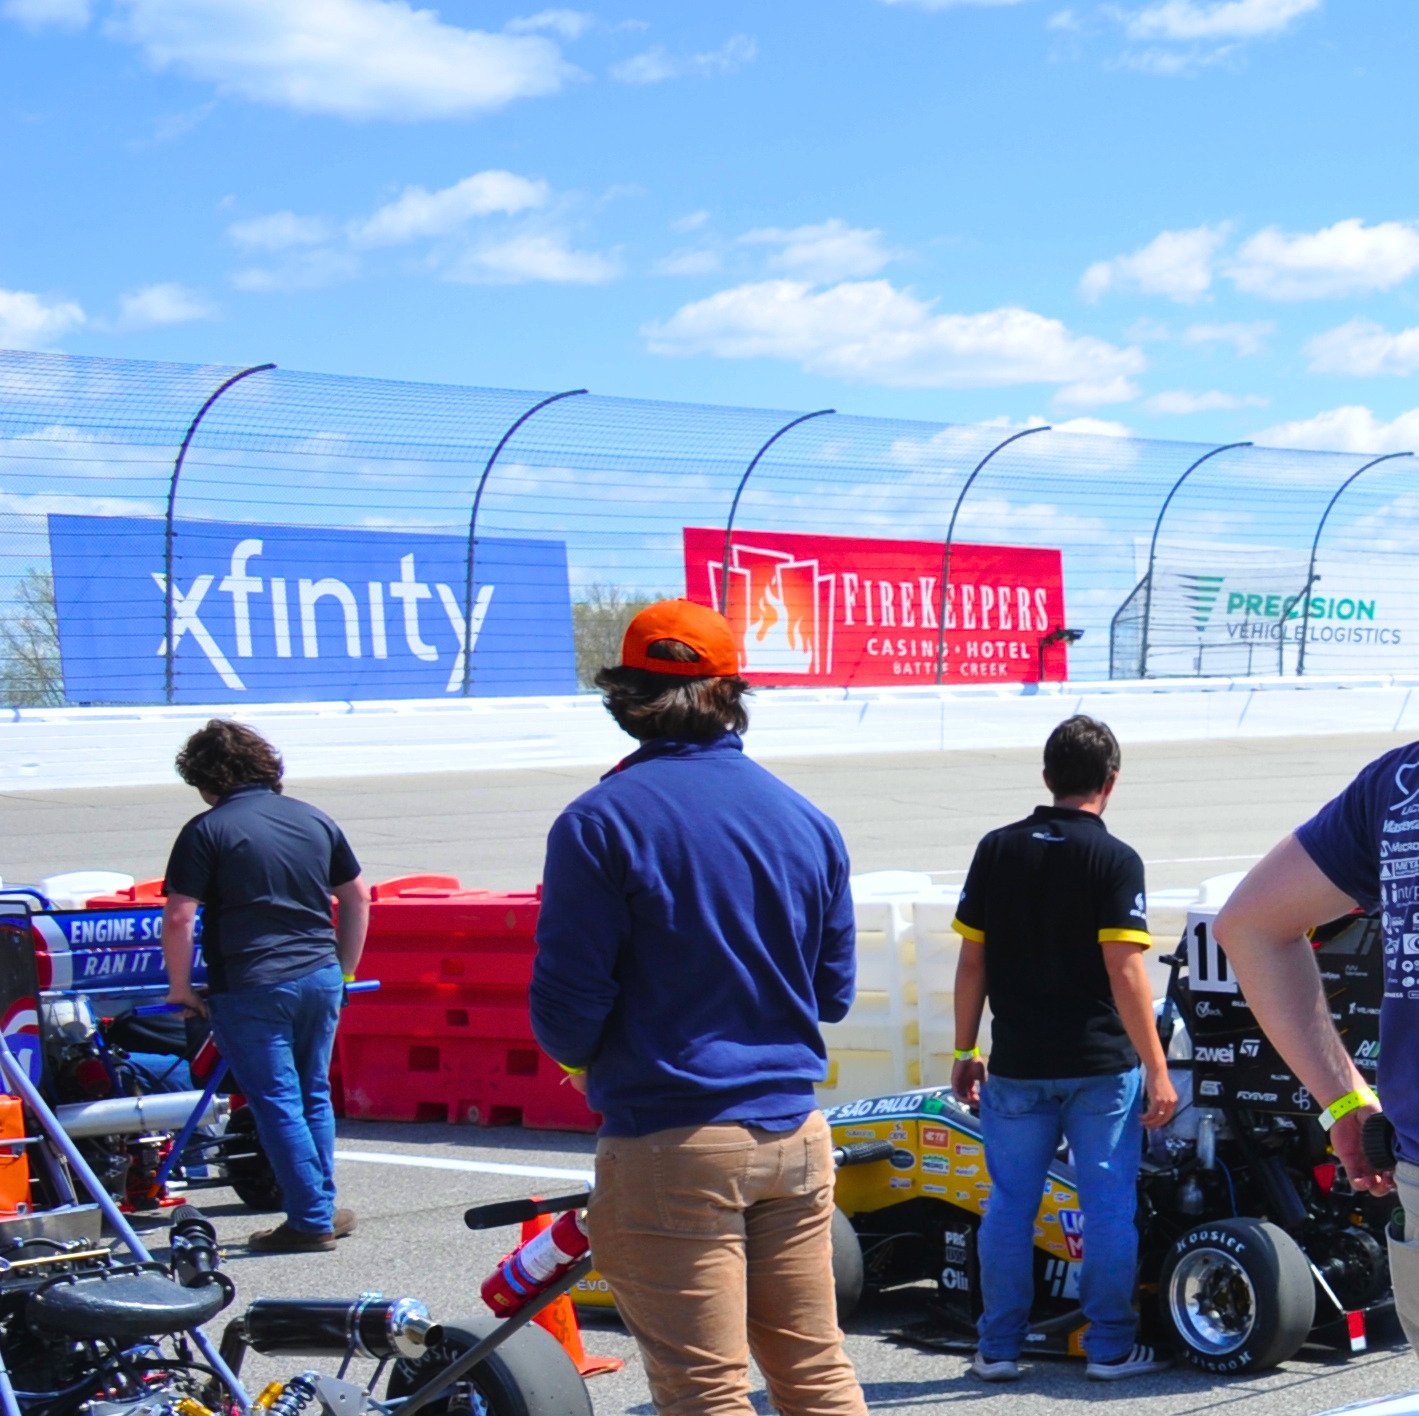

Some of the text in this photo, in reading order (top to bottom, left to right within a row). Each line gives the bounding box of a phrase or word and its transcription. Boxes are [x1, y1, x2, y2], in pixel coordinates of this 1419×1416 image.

[151, 539, 494, 692] xfinity
[1227, 592, 1376, 621] PRECISION
[1227, 623, 1402, 645] VEHICLE LOGISTICS
[867, 638, 1031, 660] CASINO HOTEL
[961, 662, 1008, 676] CREEK
[70, 920, 135, 943] ENGINE
[1194, 922, 1228, 981] 11
[84, 952, 151, 976] RAN IT
[1195, 1043, 1234, 1063] zwei
[841, 1099, 871, 1119] SÃO
[872, 1094, 922, 1116] PAULO
[1176, 1230, 1246, 1253] Hoosier
[576, 1279, 609, 1291] EVO
[398, 1345, 459, 1384] Hoosie
